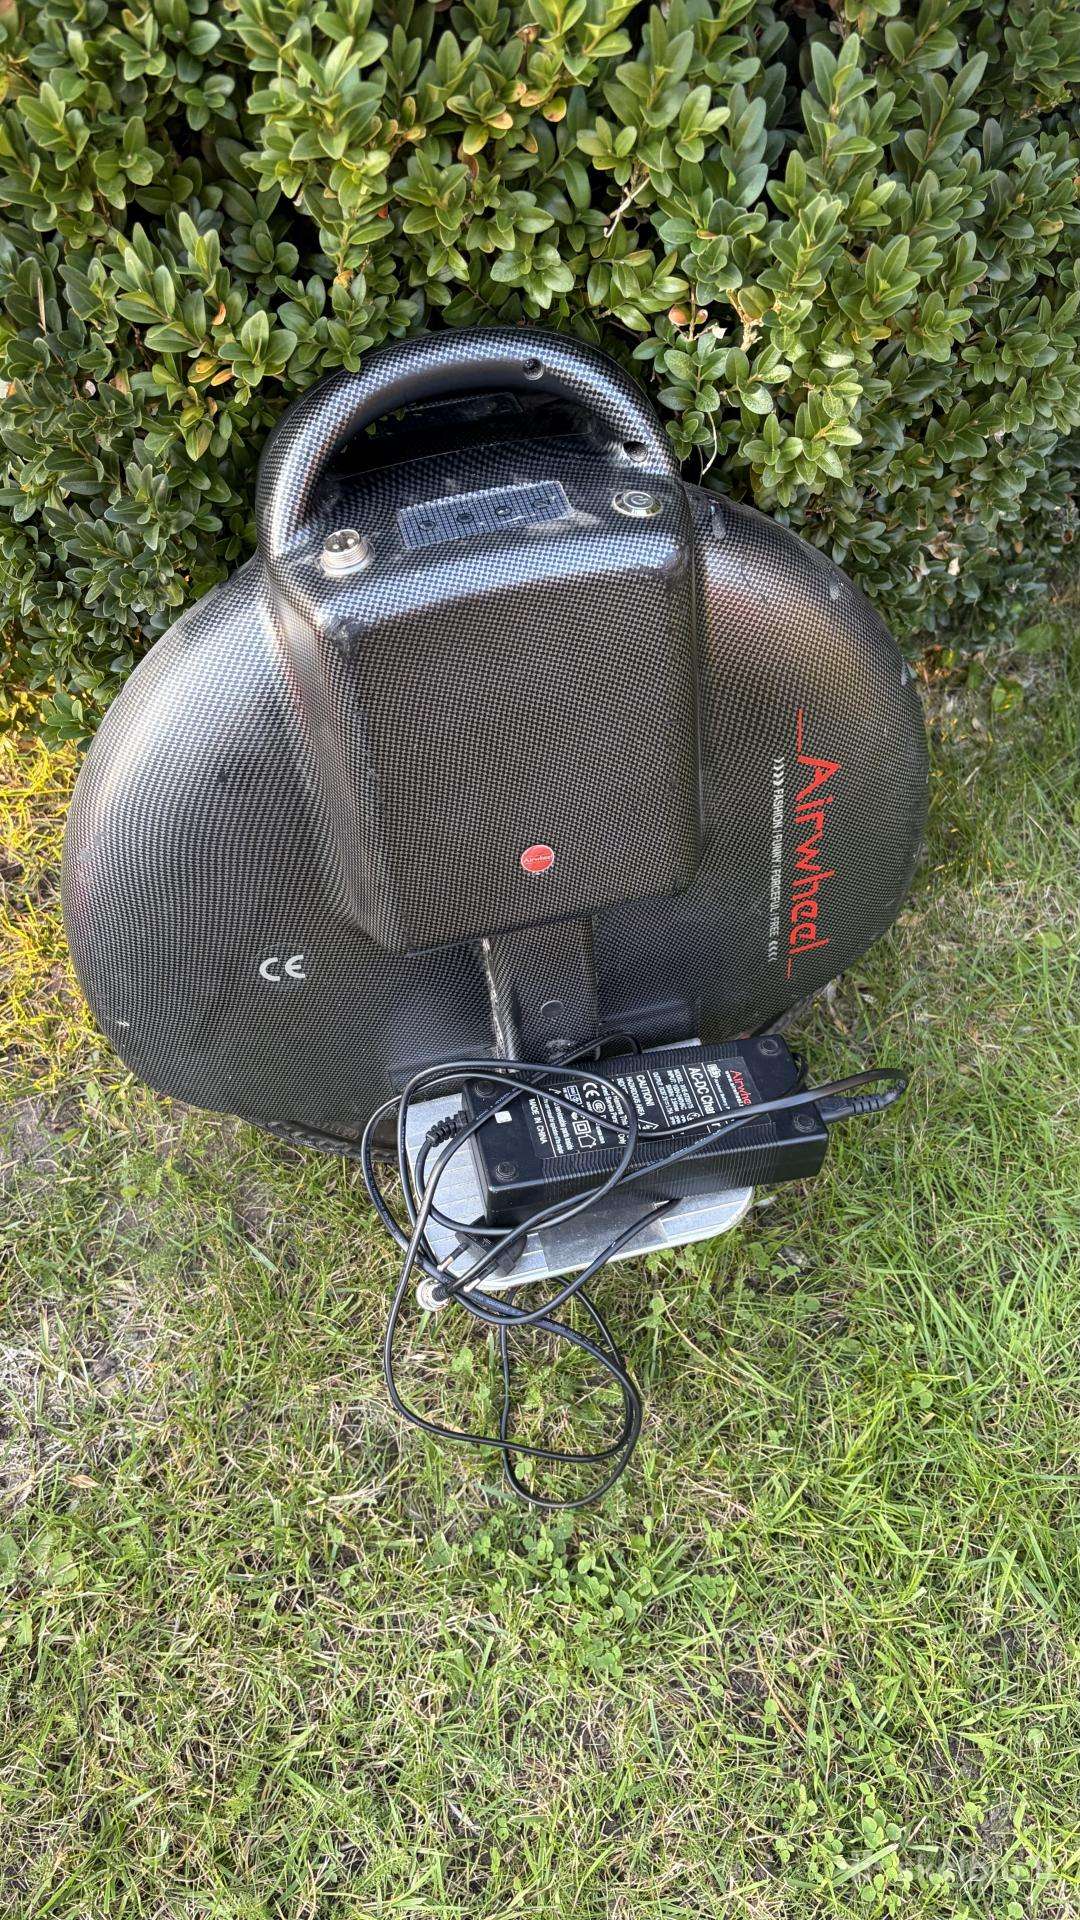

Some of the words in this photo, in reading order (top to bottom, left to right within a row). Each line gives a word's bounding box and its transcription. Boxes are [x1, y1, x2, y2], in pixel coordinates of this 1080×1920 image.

[772, 788, 784, 829] FASHION
[771, 834, 783, 862] FUNNY
[788, 754, 842, 954] Airwheel
[770, 869, 781, 912] FORCEFUL
[769, 917, 780, 937] FREE
[259, 954, 306, 981] CE
[583, 1082, 599, 1099] CE
[627, 1077, 640, 1103] HAZARDOUS
[635, 1103, 645, 1116] AREA
[639, 1074, 654, 1106] CAUTION!
[688, 1067, 709, 1094] AC-DC
[730, 1070, 751, 1105] Airwhe
[528, 1098, 539, 1115] MADE
[536, 1125, 547, 1144] CHINA
